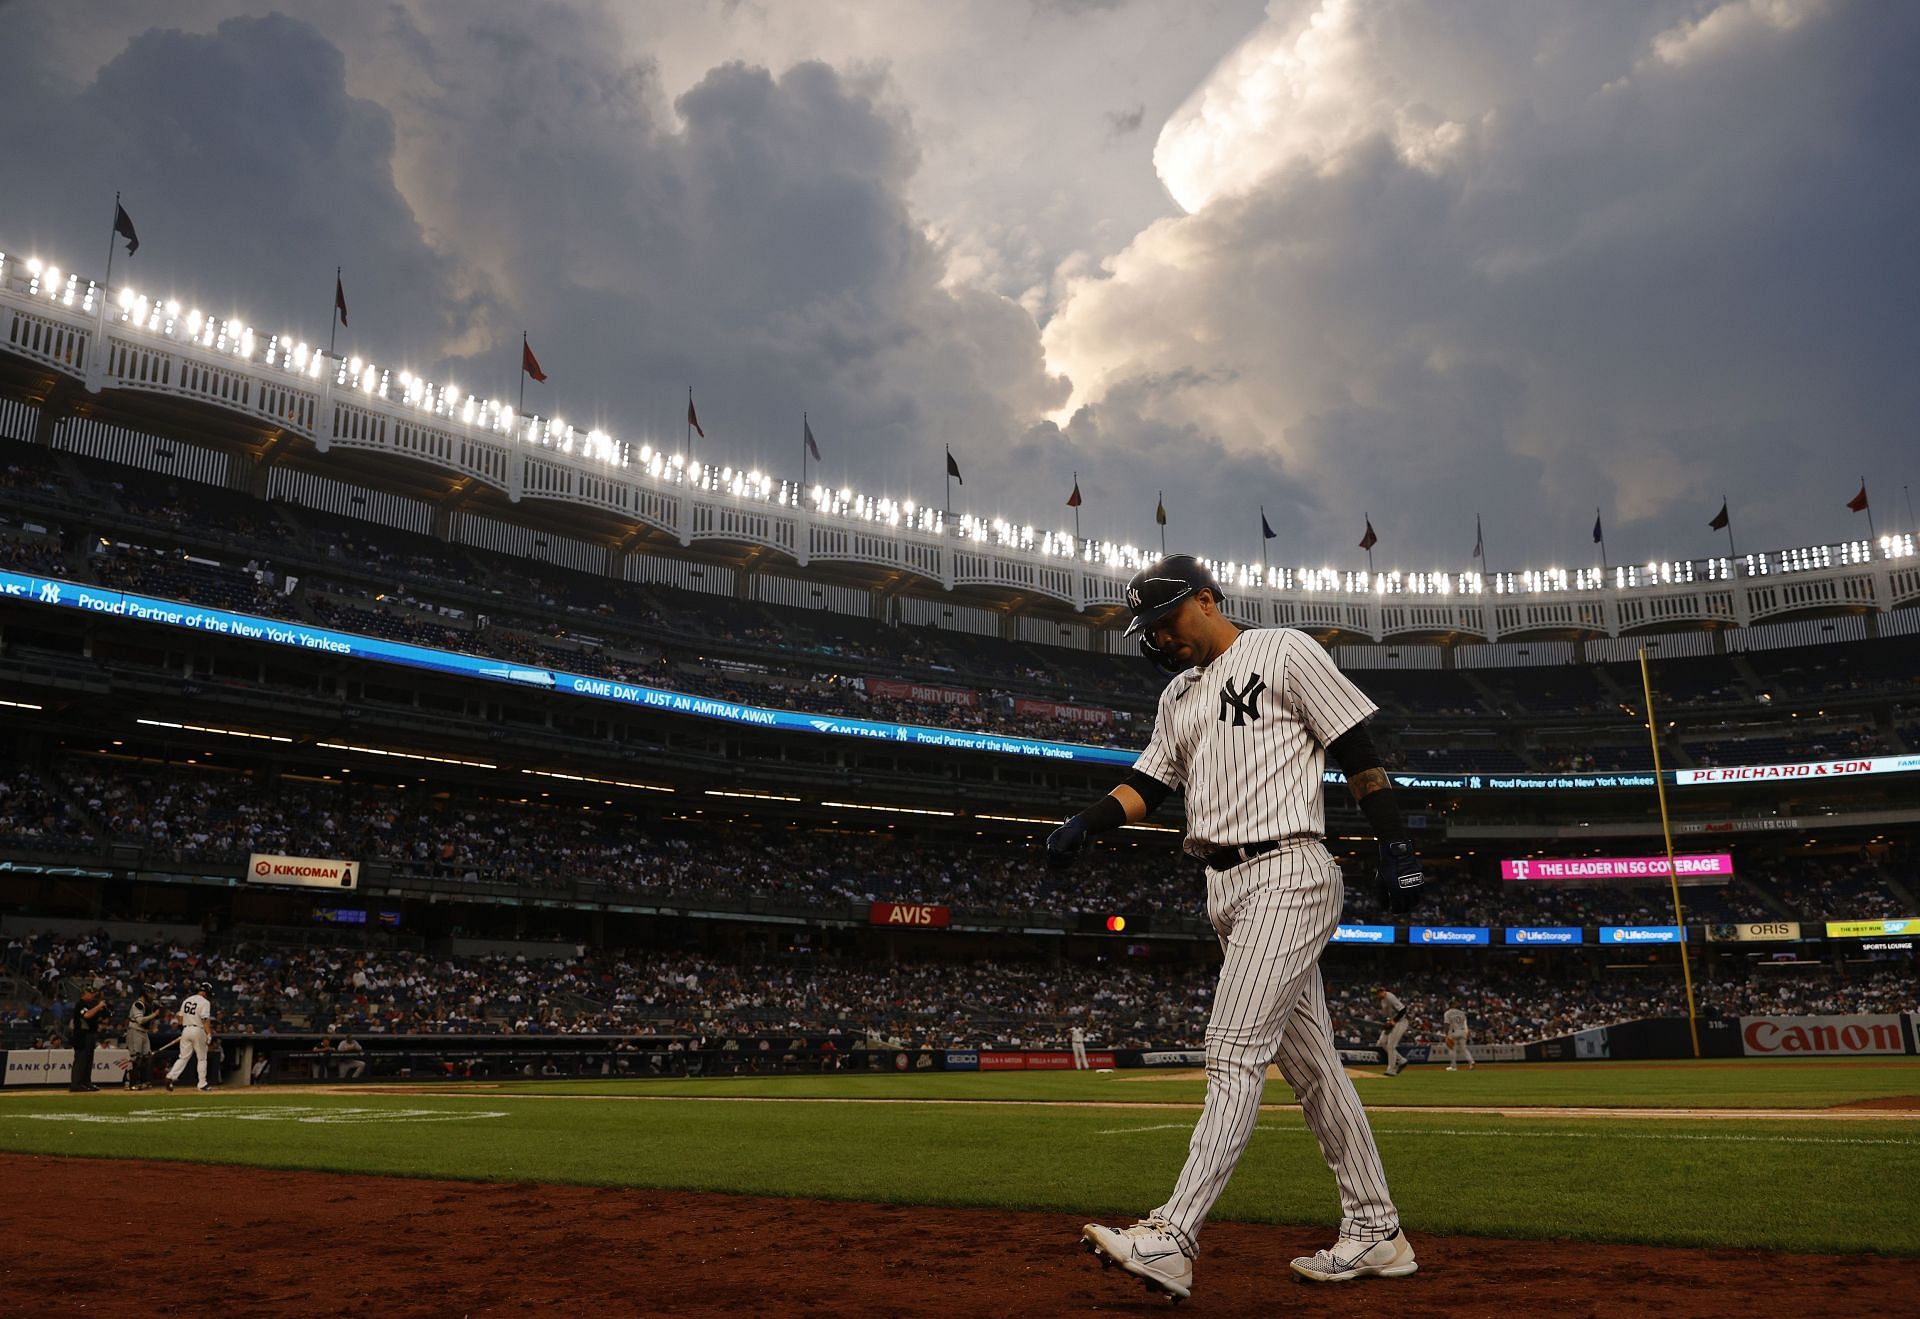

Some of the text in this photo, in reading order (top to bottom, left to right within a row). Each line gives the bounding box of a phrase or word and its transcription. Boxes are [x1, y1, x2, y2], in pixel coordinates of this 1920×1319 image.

[78, 594, 351, 654] Proud Partner of the New York Yankees
[574, 679, 777, 725] GAME DAY. JUST AN AMTRAK AWAY.
[911, 687, 943, 702] PARTY
[944, 691, 971, 705] DECK
[1055, 705, 1082, 720] PARTY
[1084, 708, 1108, 722] DECK
[830, 725, 887, 738] AMTRAK
[917, 733, 1073, 759] Proud Partner of the New York Yankees
[1693, 761, 1872, 782] PC RICHARD & SON
[1412, 779, 1463, 788] AMTRAK
[1490, 776, 1654, 788] Proud Partner of the New York Yankees
[1705, 819, 1798, 831] Audi YANKEES CLUB
[273, 865, 338, 878] KIKKOMAN
[1538, 863, 1563, 876] THE
[1565, 862, 1612, 875] LEADER
[1614, 861, 1628, 874] IN
[1630, 860, 1647, 873] 5G
[888, 906, 931, 925] AVIS
[1750, 924, 1789, 935] ORIS
[1884, 922, 1905, 933] SAP
[1862, 942, 1913, 951] SPORTS LOUNGE
[184, 1001, 198, 1015] 62
[1744, 1021, 1901, 1052] Canon
[947, 1054, 977, 1064] GEICO
[9, 1063, 40, 1071] BANK
[43, 1062, 57, 1071] OF
